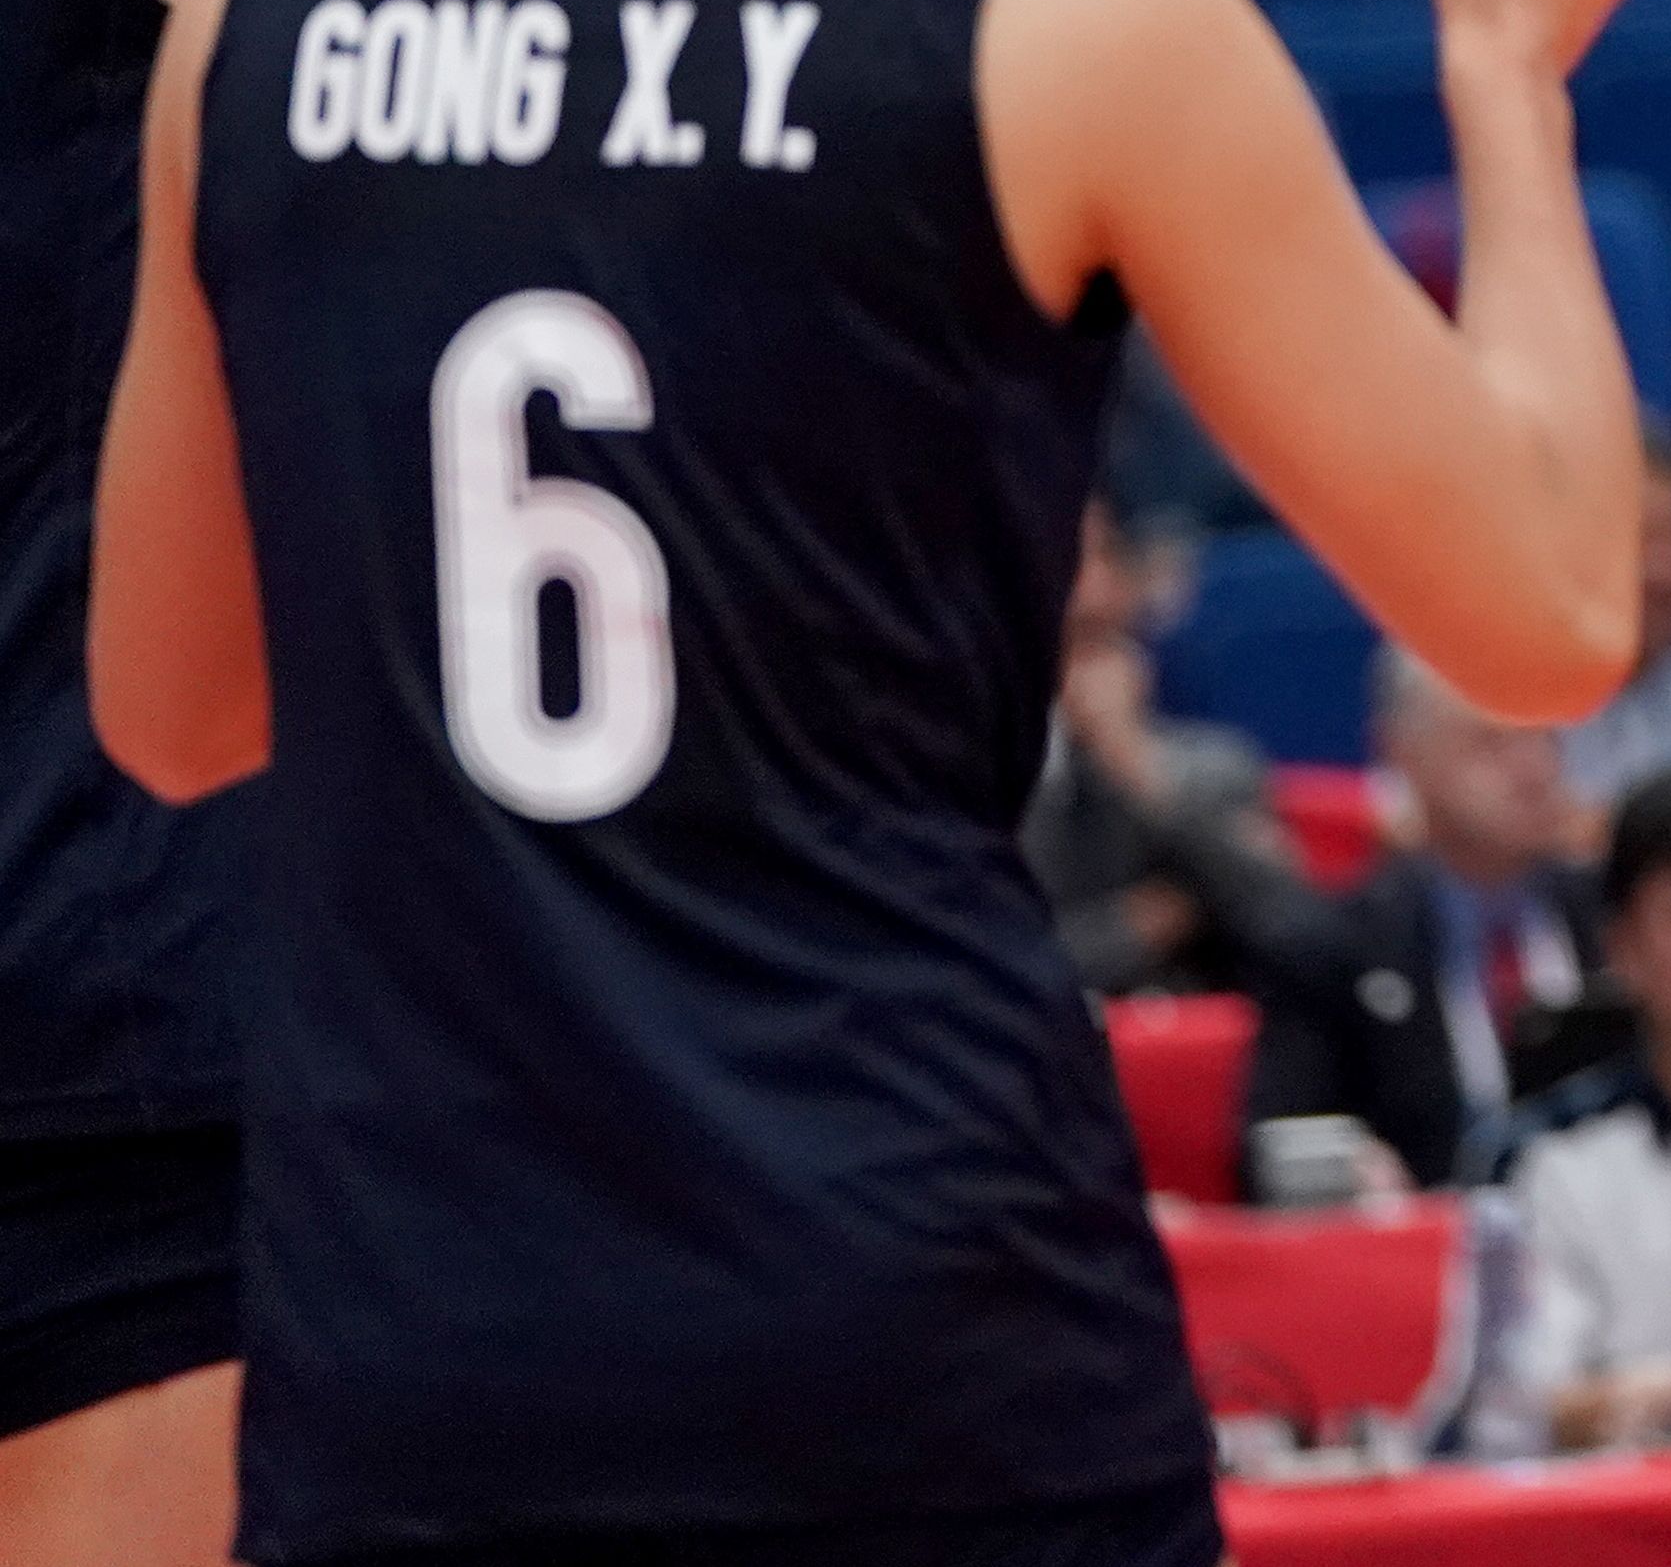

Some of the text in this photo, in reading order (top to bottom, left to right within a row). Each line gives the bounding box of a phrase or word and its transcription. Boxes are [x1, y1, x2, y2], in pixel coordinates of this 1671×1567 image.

[602, 0, 705, 166] X.
[740, 1, 820, 170] Y.
[431, 289, 676, 821] 6
